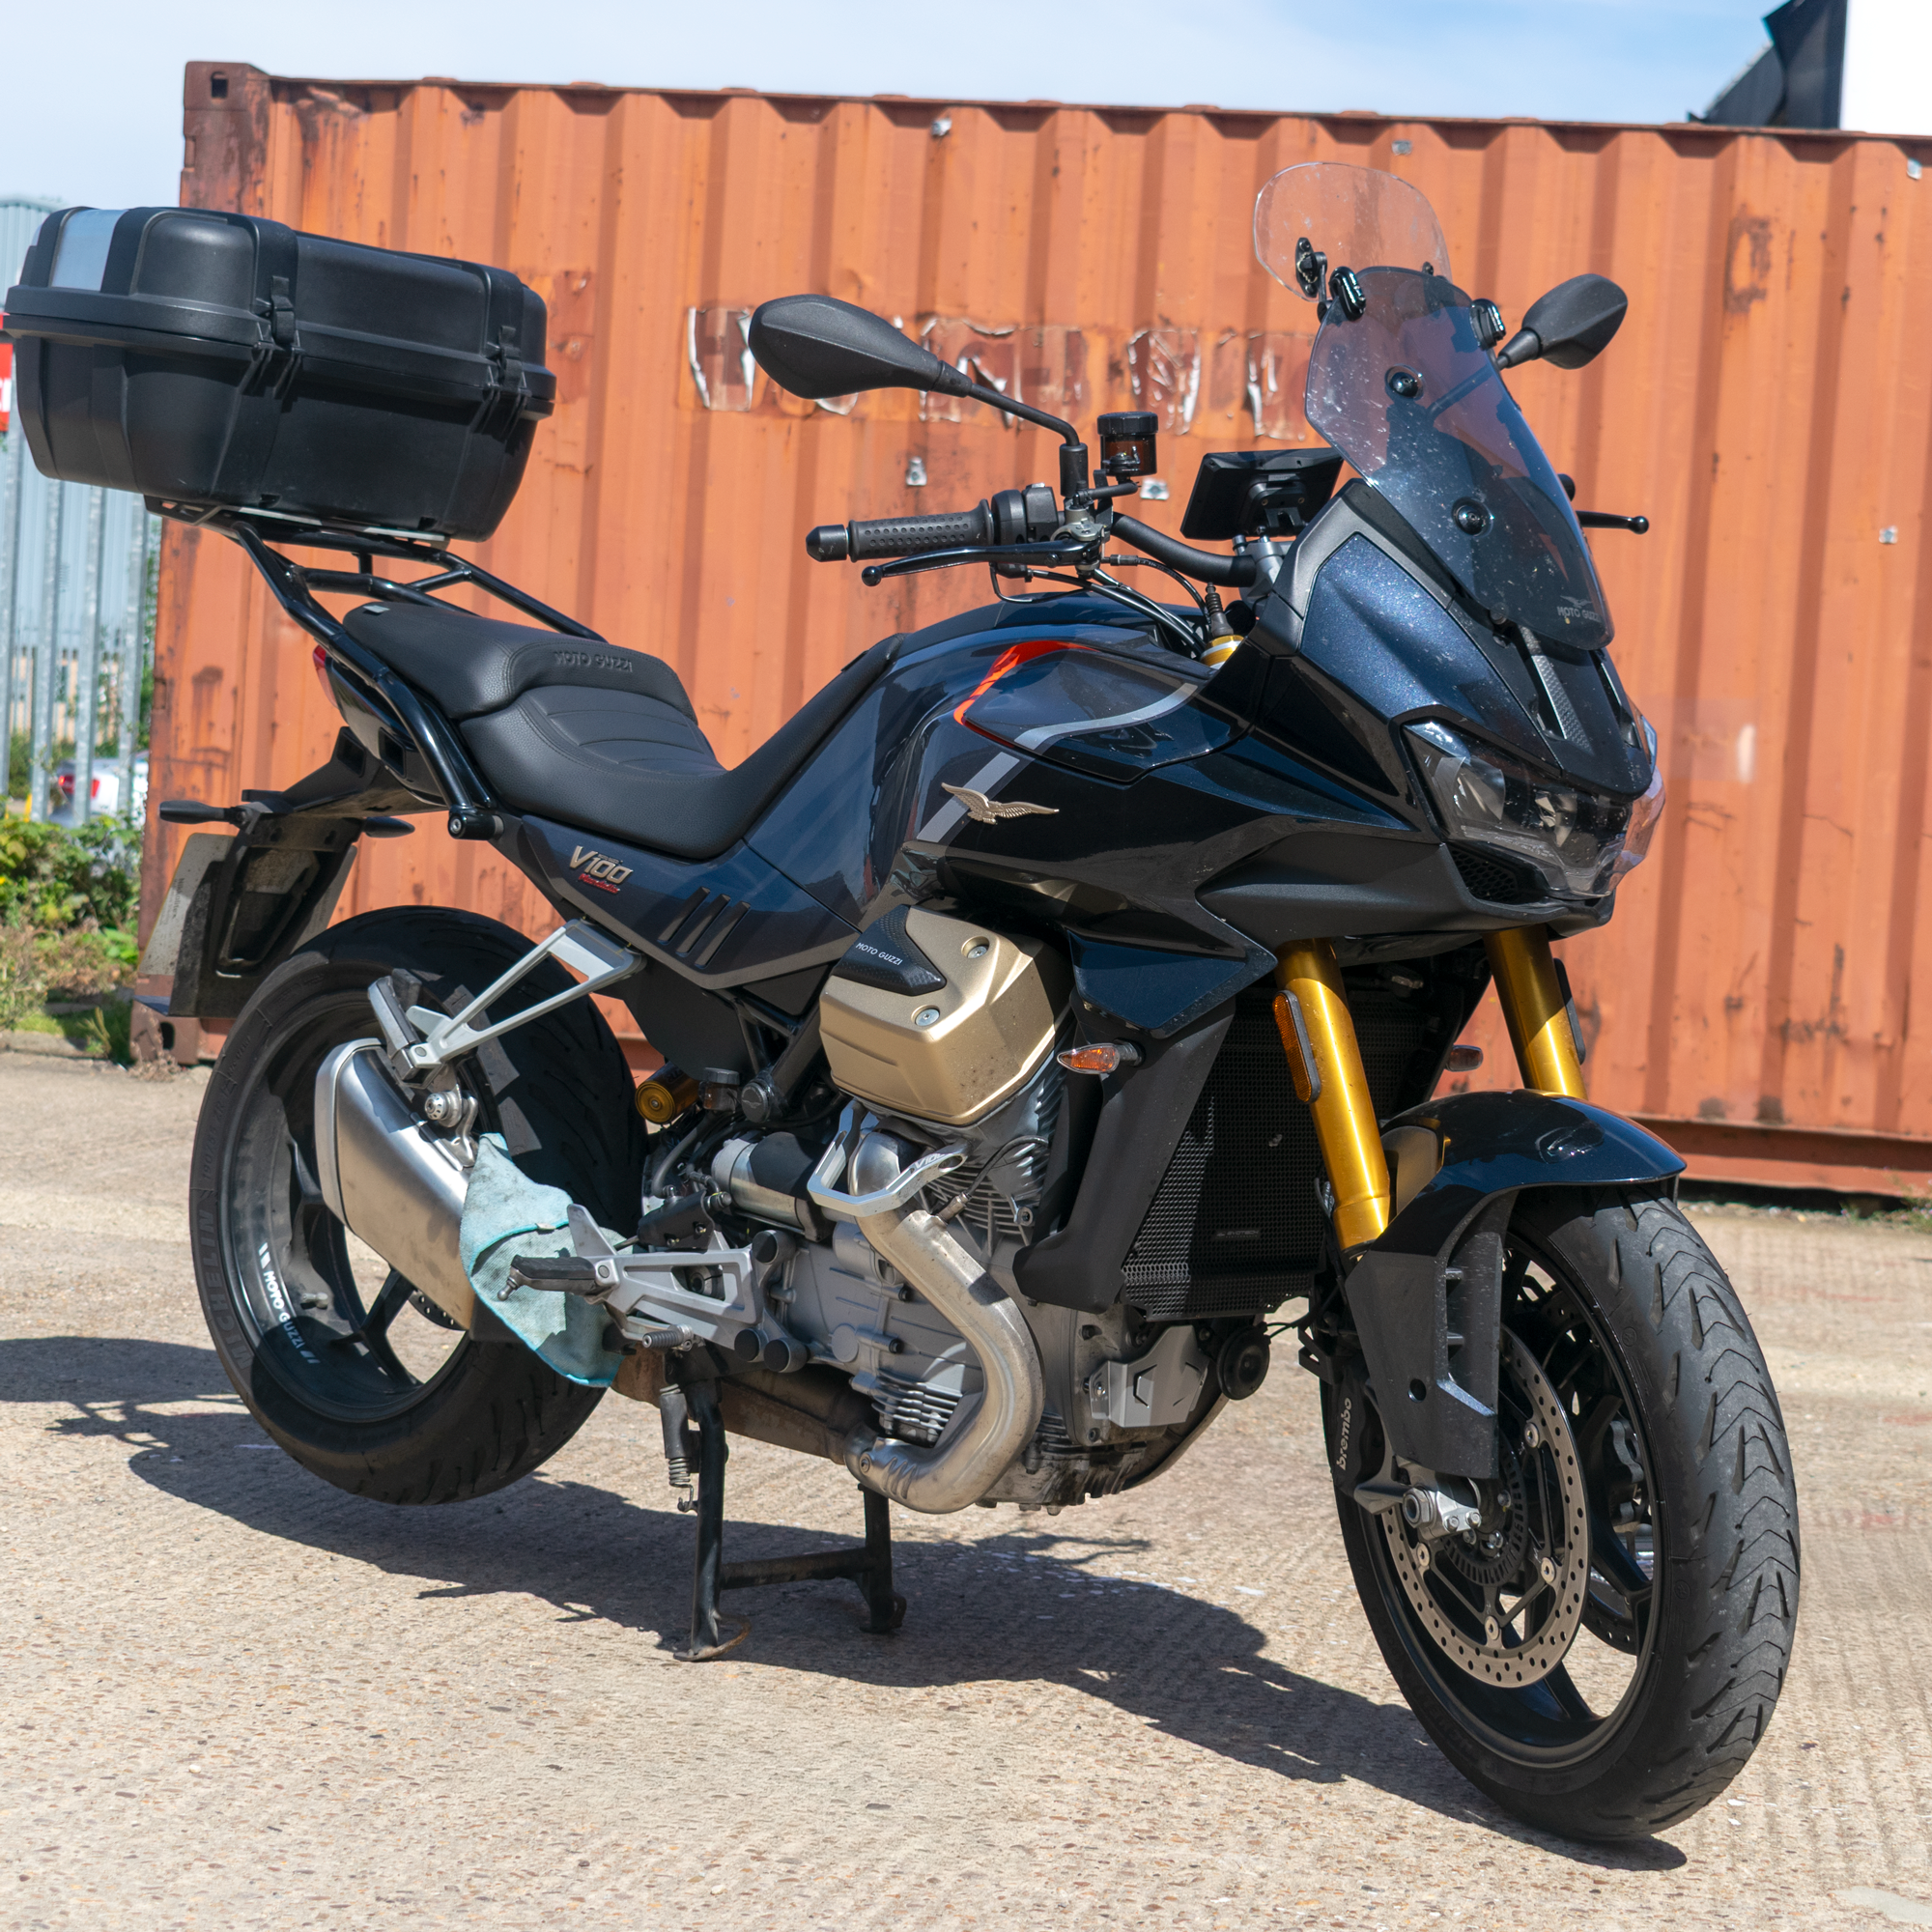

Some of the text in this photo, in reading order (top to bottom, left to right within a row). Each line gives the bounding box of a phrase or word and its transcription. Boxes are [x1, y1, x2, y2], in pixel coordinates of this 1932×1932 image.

[1556, 606, 1580, 618] MOTO
[554, 651, 633, 672] MOTO GUZZI
[569, 845, 634, 884] V100
[855, 942, 903, 966] MOTO GUZZI
[198, 1208, 254, 1372] MICHELIN
[263, 1270, 305, 1349] MOTO GUZZI
[1336, 1397, 1352, 1470] brembo
